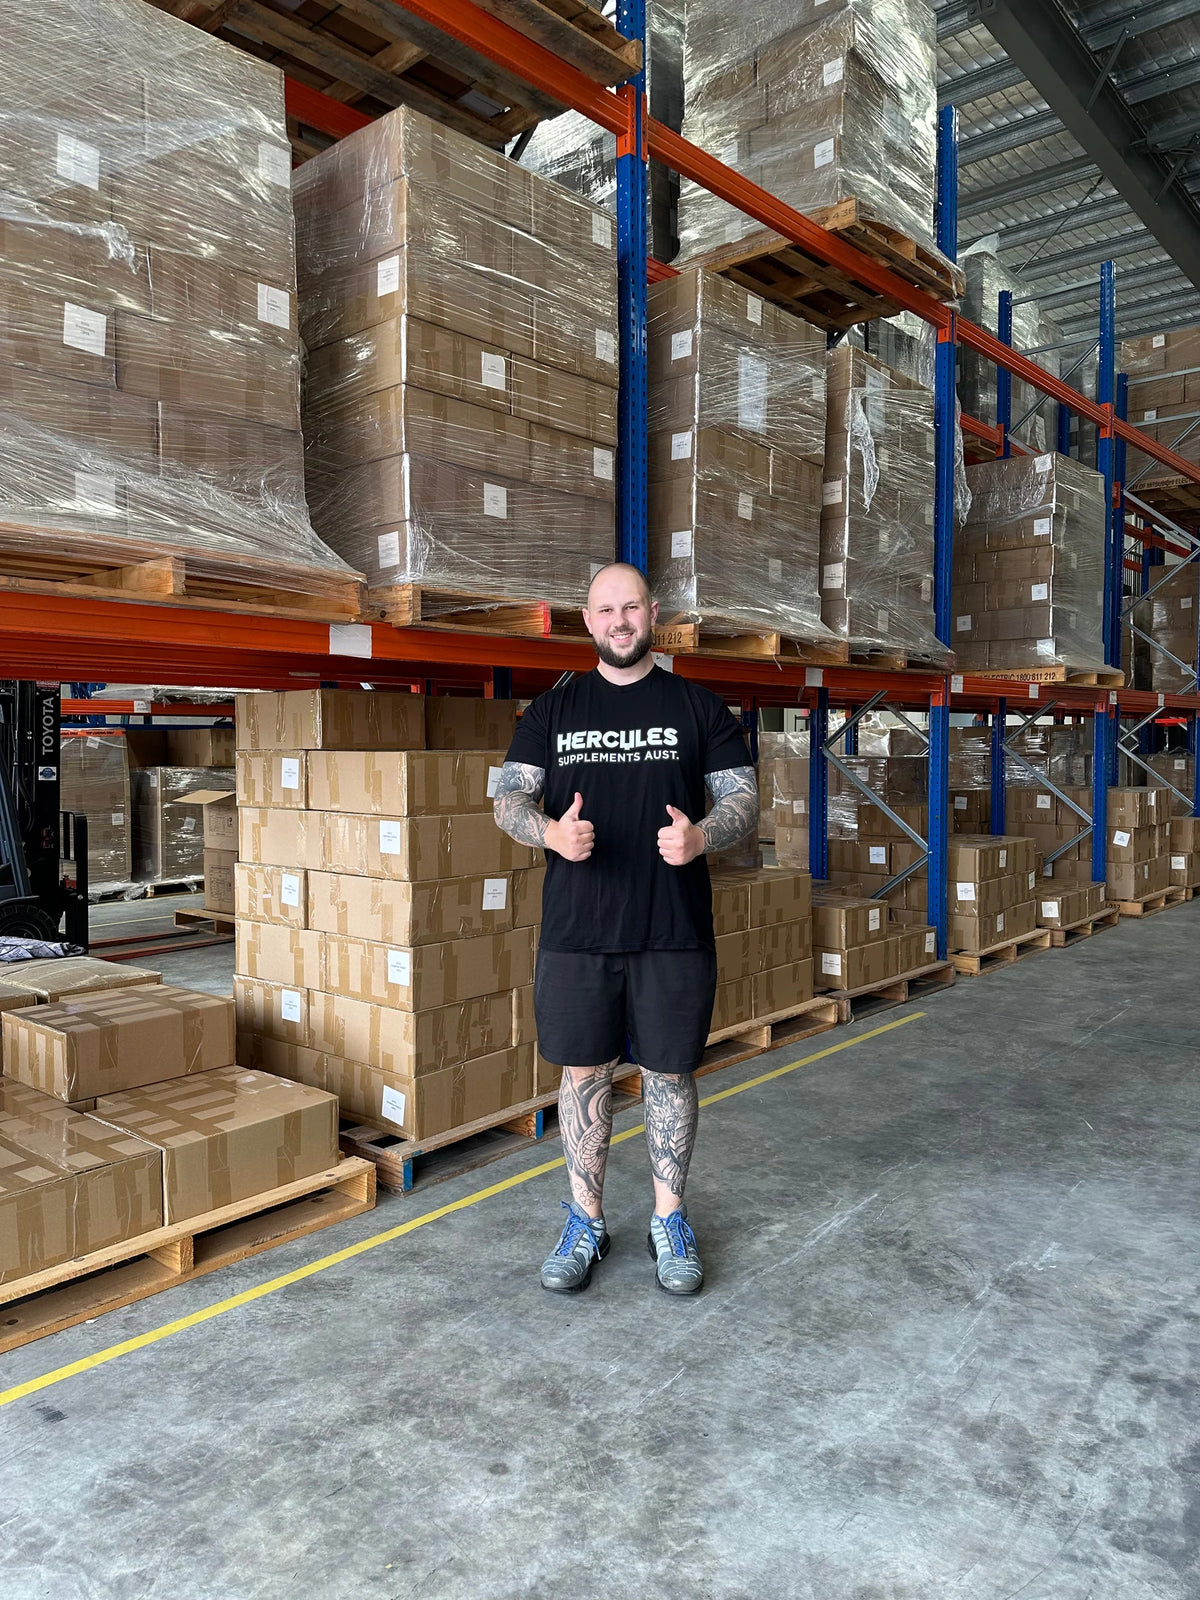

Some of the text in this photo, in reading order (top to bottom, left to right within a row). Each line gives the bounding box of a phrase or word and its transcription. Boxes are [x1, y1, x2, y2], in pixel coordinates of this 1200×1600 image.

[667, 631, 682, 645] 212
[1031, 673, 1042, 681] 811
[1044, 672, 1056, 680] 212
[42, 697, 54, 755] TOYOTA
[557, 727, 678, 753] HERCULES
[558, 750, 680, 767] SUPPLEMENTS AUST.
